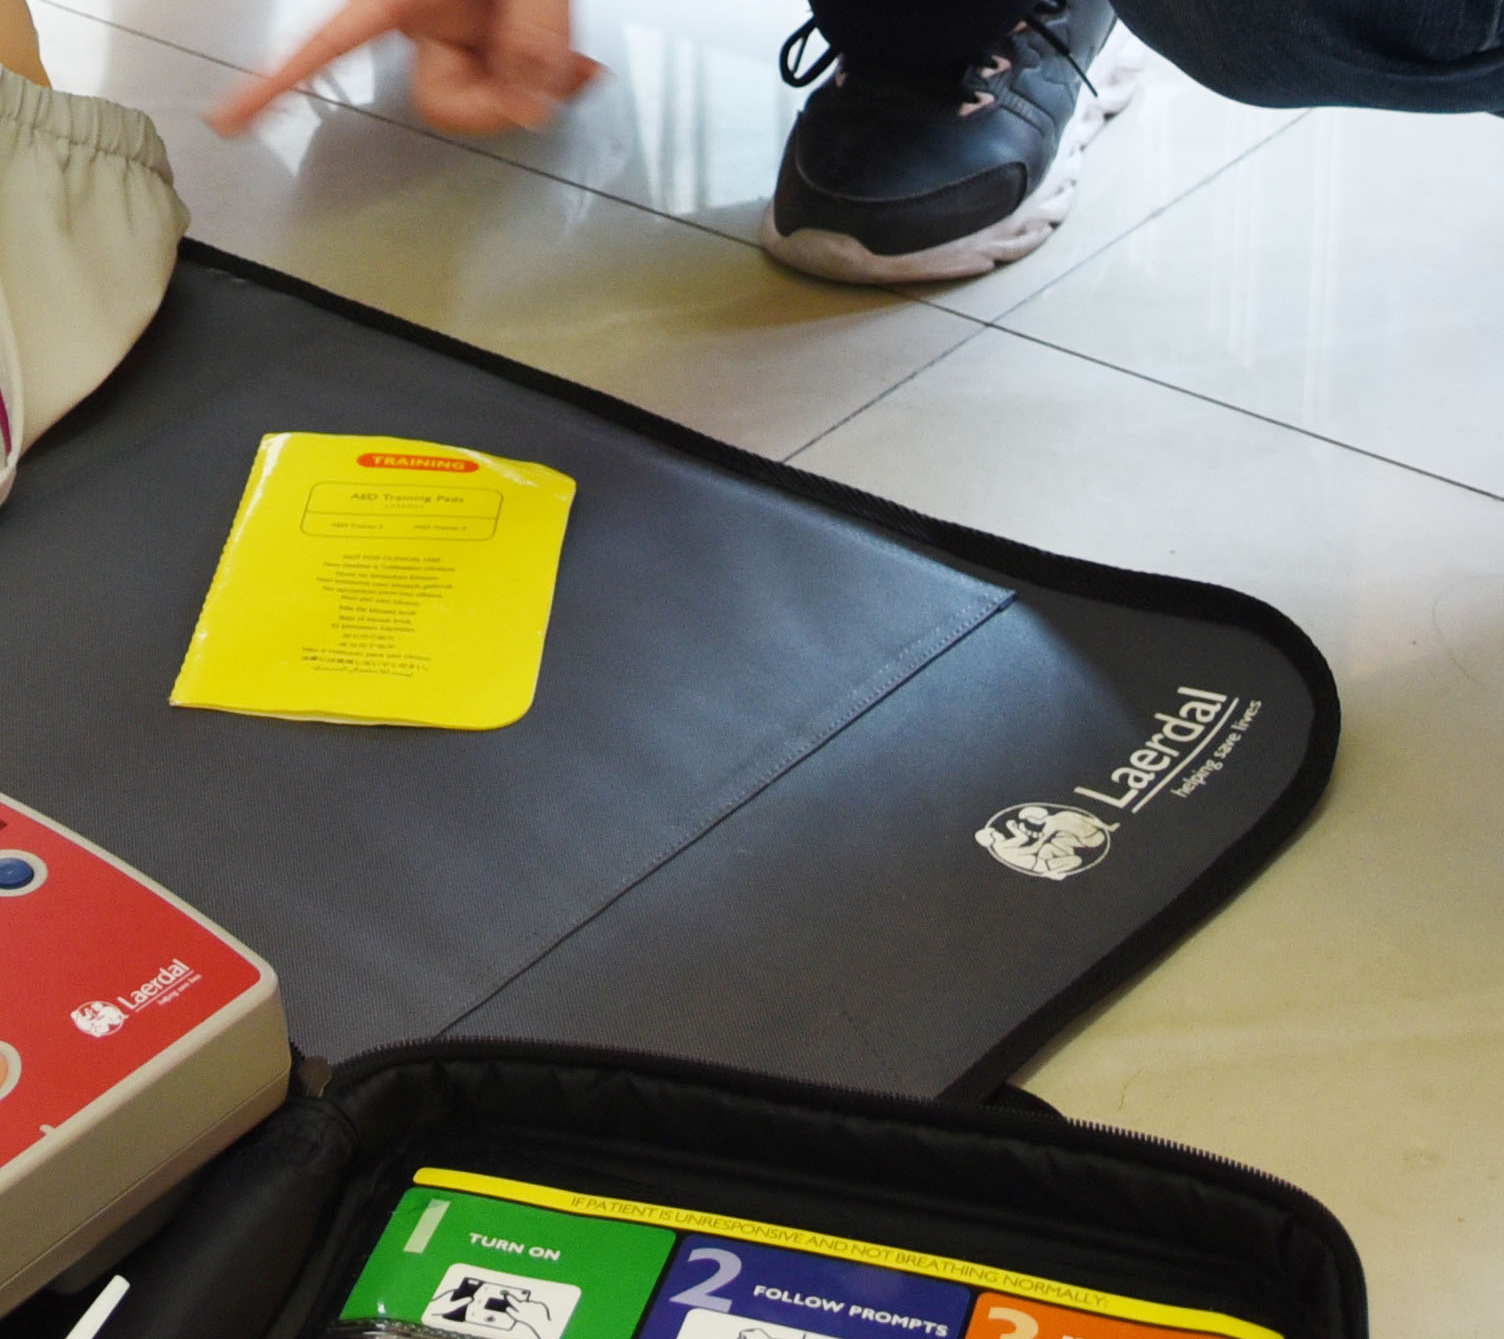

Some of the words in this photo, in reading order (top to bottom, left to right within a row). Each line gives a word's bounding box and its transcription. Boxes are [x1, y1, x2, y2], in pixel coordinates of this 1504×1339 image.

[372, 455, 465, 471] TRAINING
[350, 492, 379, 501] AED
[383, 493, 432, 504] Training
[435, 494, 465, 504] Pads
[1073, 686, 1228, 809] Laerdal
[1170, 757, 1224, 799] helping
[1214, 729, 1242, 760] save
[1235, 699, 1262, 734] lives
[116, 958, 190, 1010] Laerdal
[403, 1198, 452, 1254] 1
[469, 1232, 525, 1256] TURN
[528, 1245, 562, 1262] ON
[571, 1196, 586, 1207] IF
[584, 1198, 658, 1219] PATIENT
[659, 1209, 673, 1221] IS
[676, 1212, 805, 1245] UNRESPONSIVE
[805, 1235, 849, 1253] AND
[851, 1243, 892, 1261] NOT
[895, 1252, 999, 1284] BREATHING
[669, 1247, 743, 1314] 2
[753, 1284, 845, 1314] FOLLOW
[848, 1305, 950, 1337] PROMPTS
